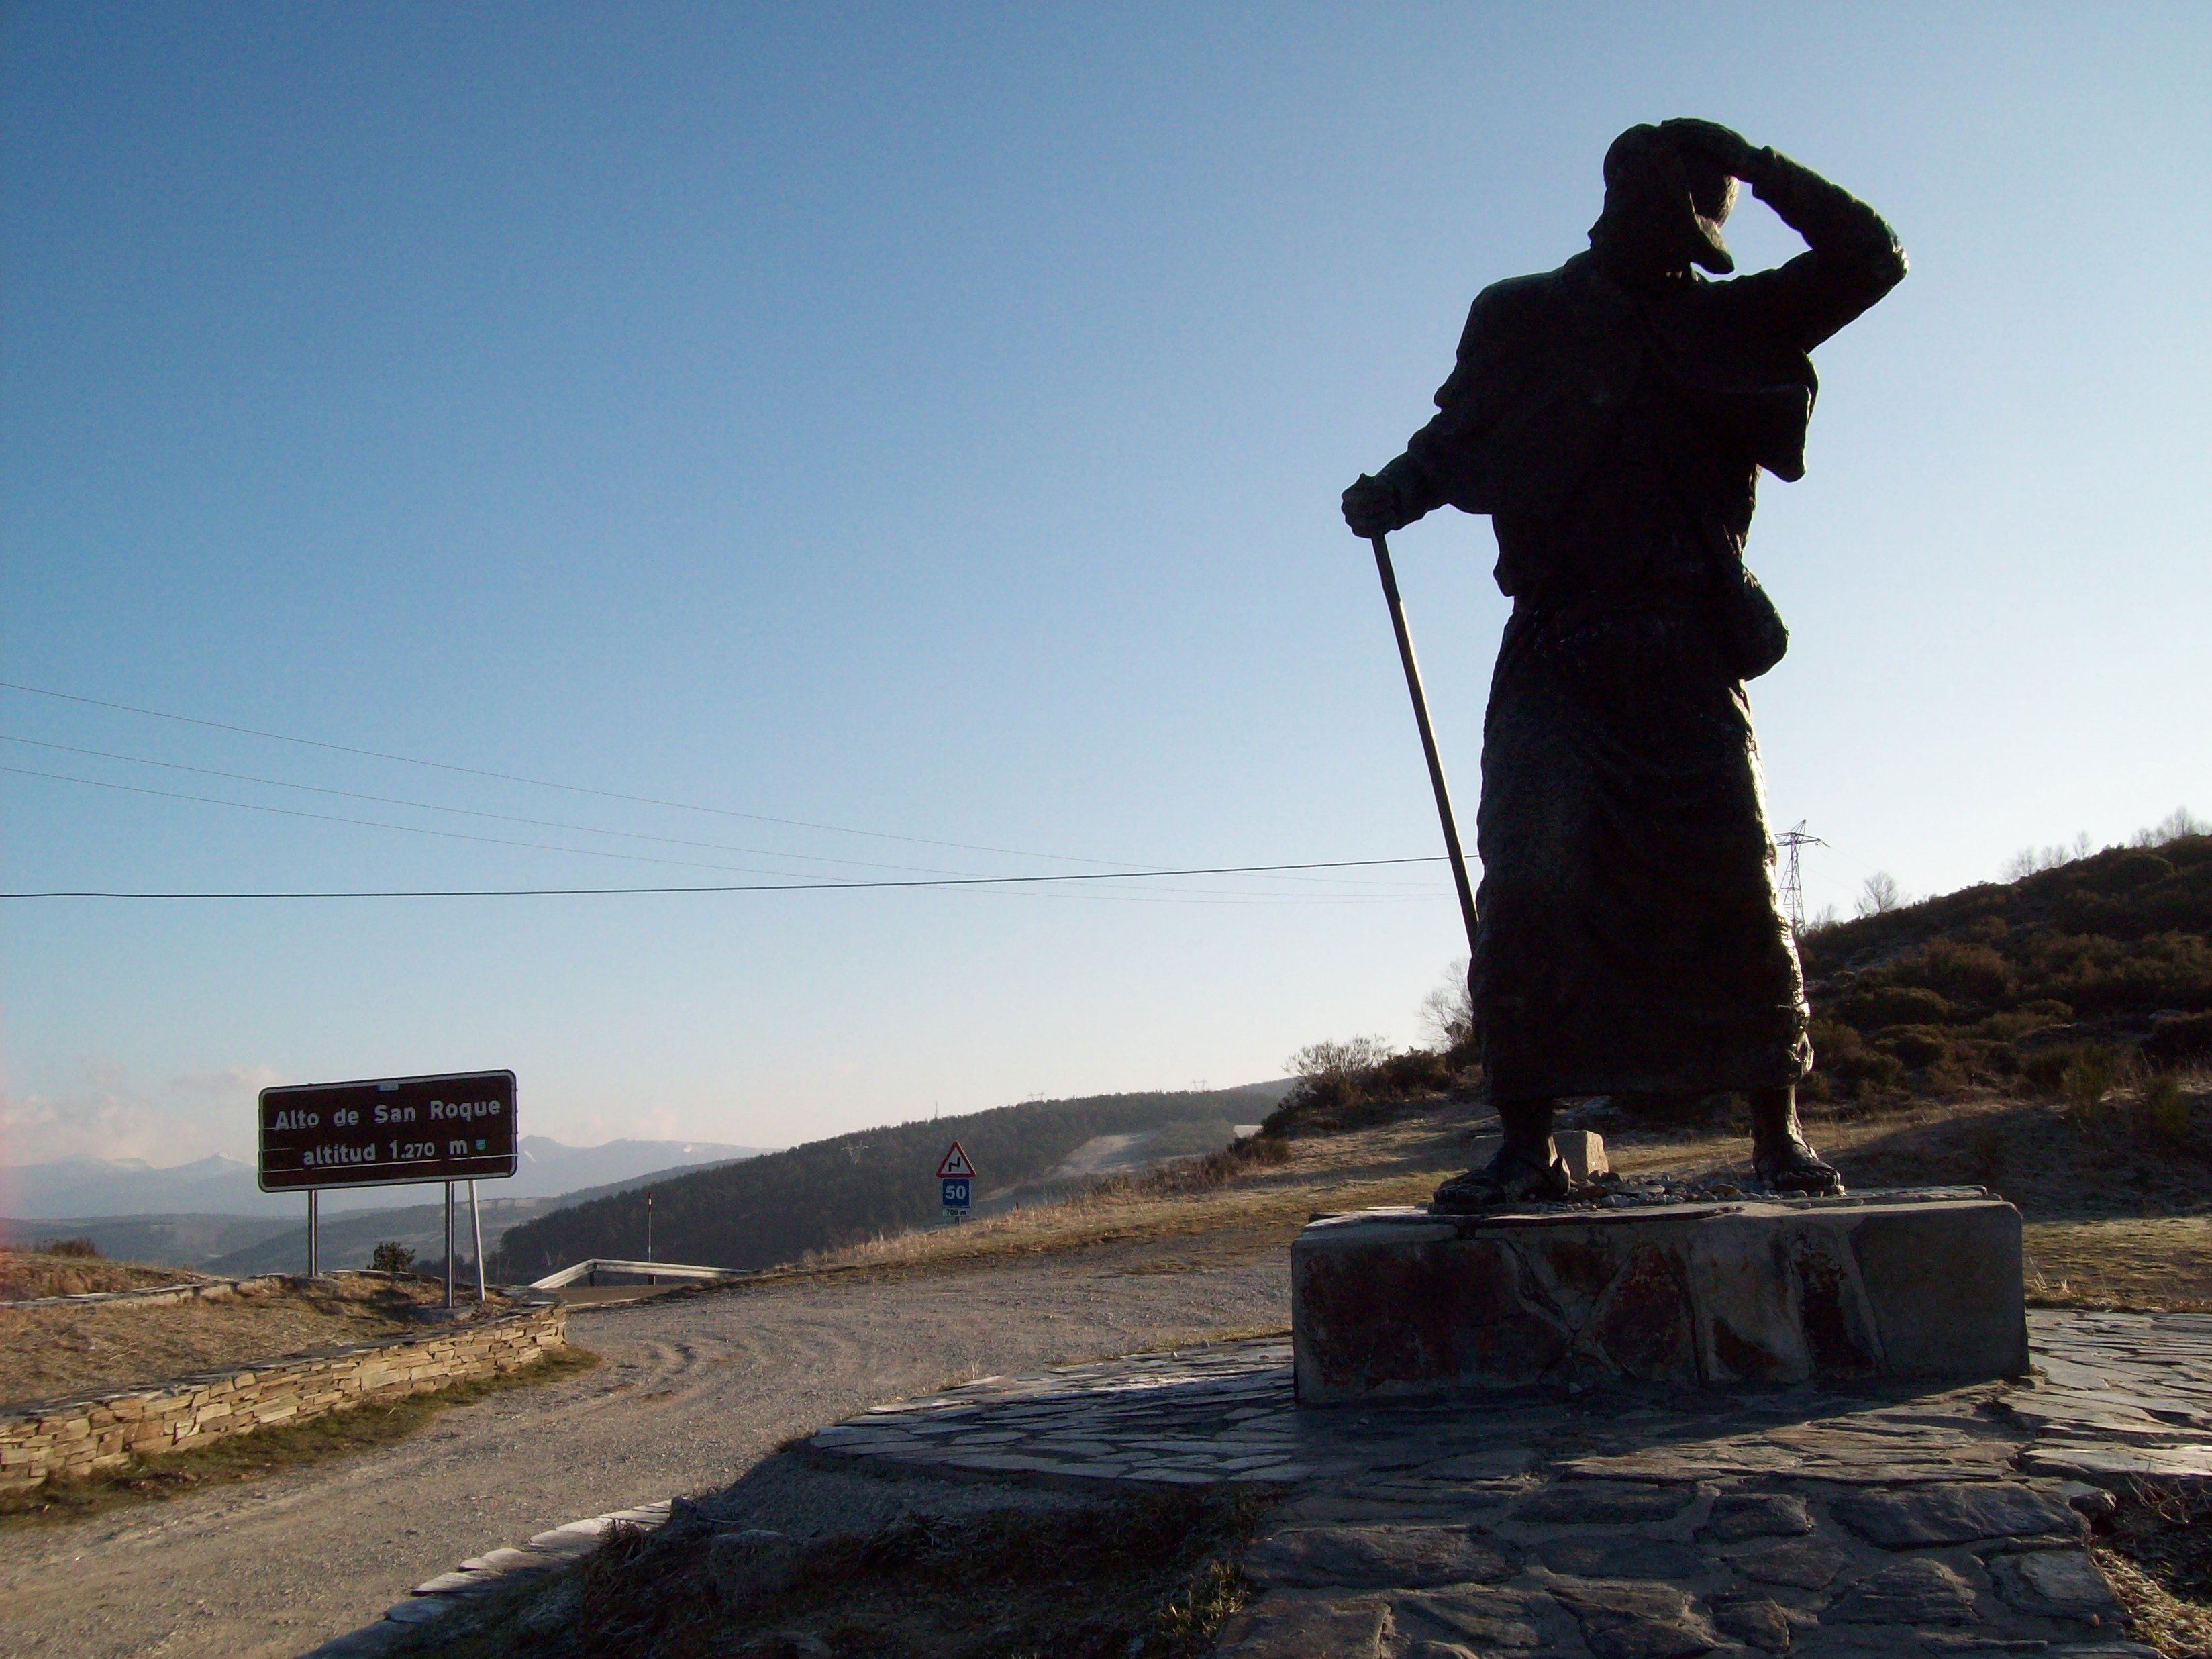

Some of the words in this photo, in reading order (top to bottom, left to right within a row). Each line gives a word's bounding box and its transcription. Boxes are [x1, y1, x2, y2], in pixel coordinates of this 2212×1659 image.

[275, 1110, 319, 1130] Alto
[334, 1108, 359, 1126] de
[374, 1104, 416, 1124] San
[430, 1099, 501, 1122] Roque
[303, 1143, 376, 1165] altitud
[389, 1140, 435, 1159] 1.270
[449, 1140, 468, 1155] m
[946, 1185, 966, 1200] 50
